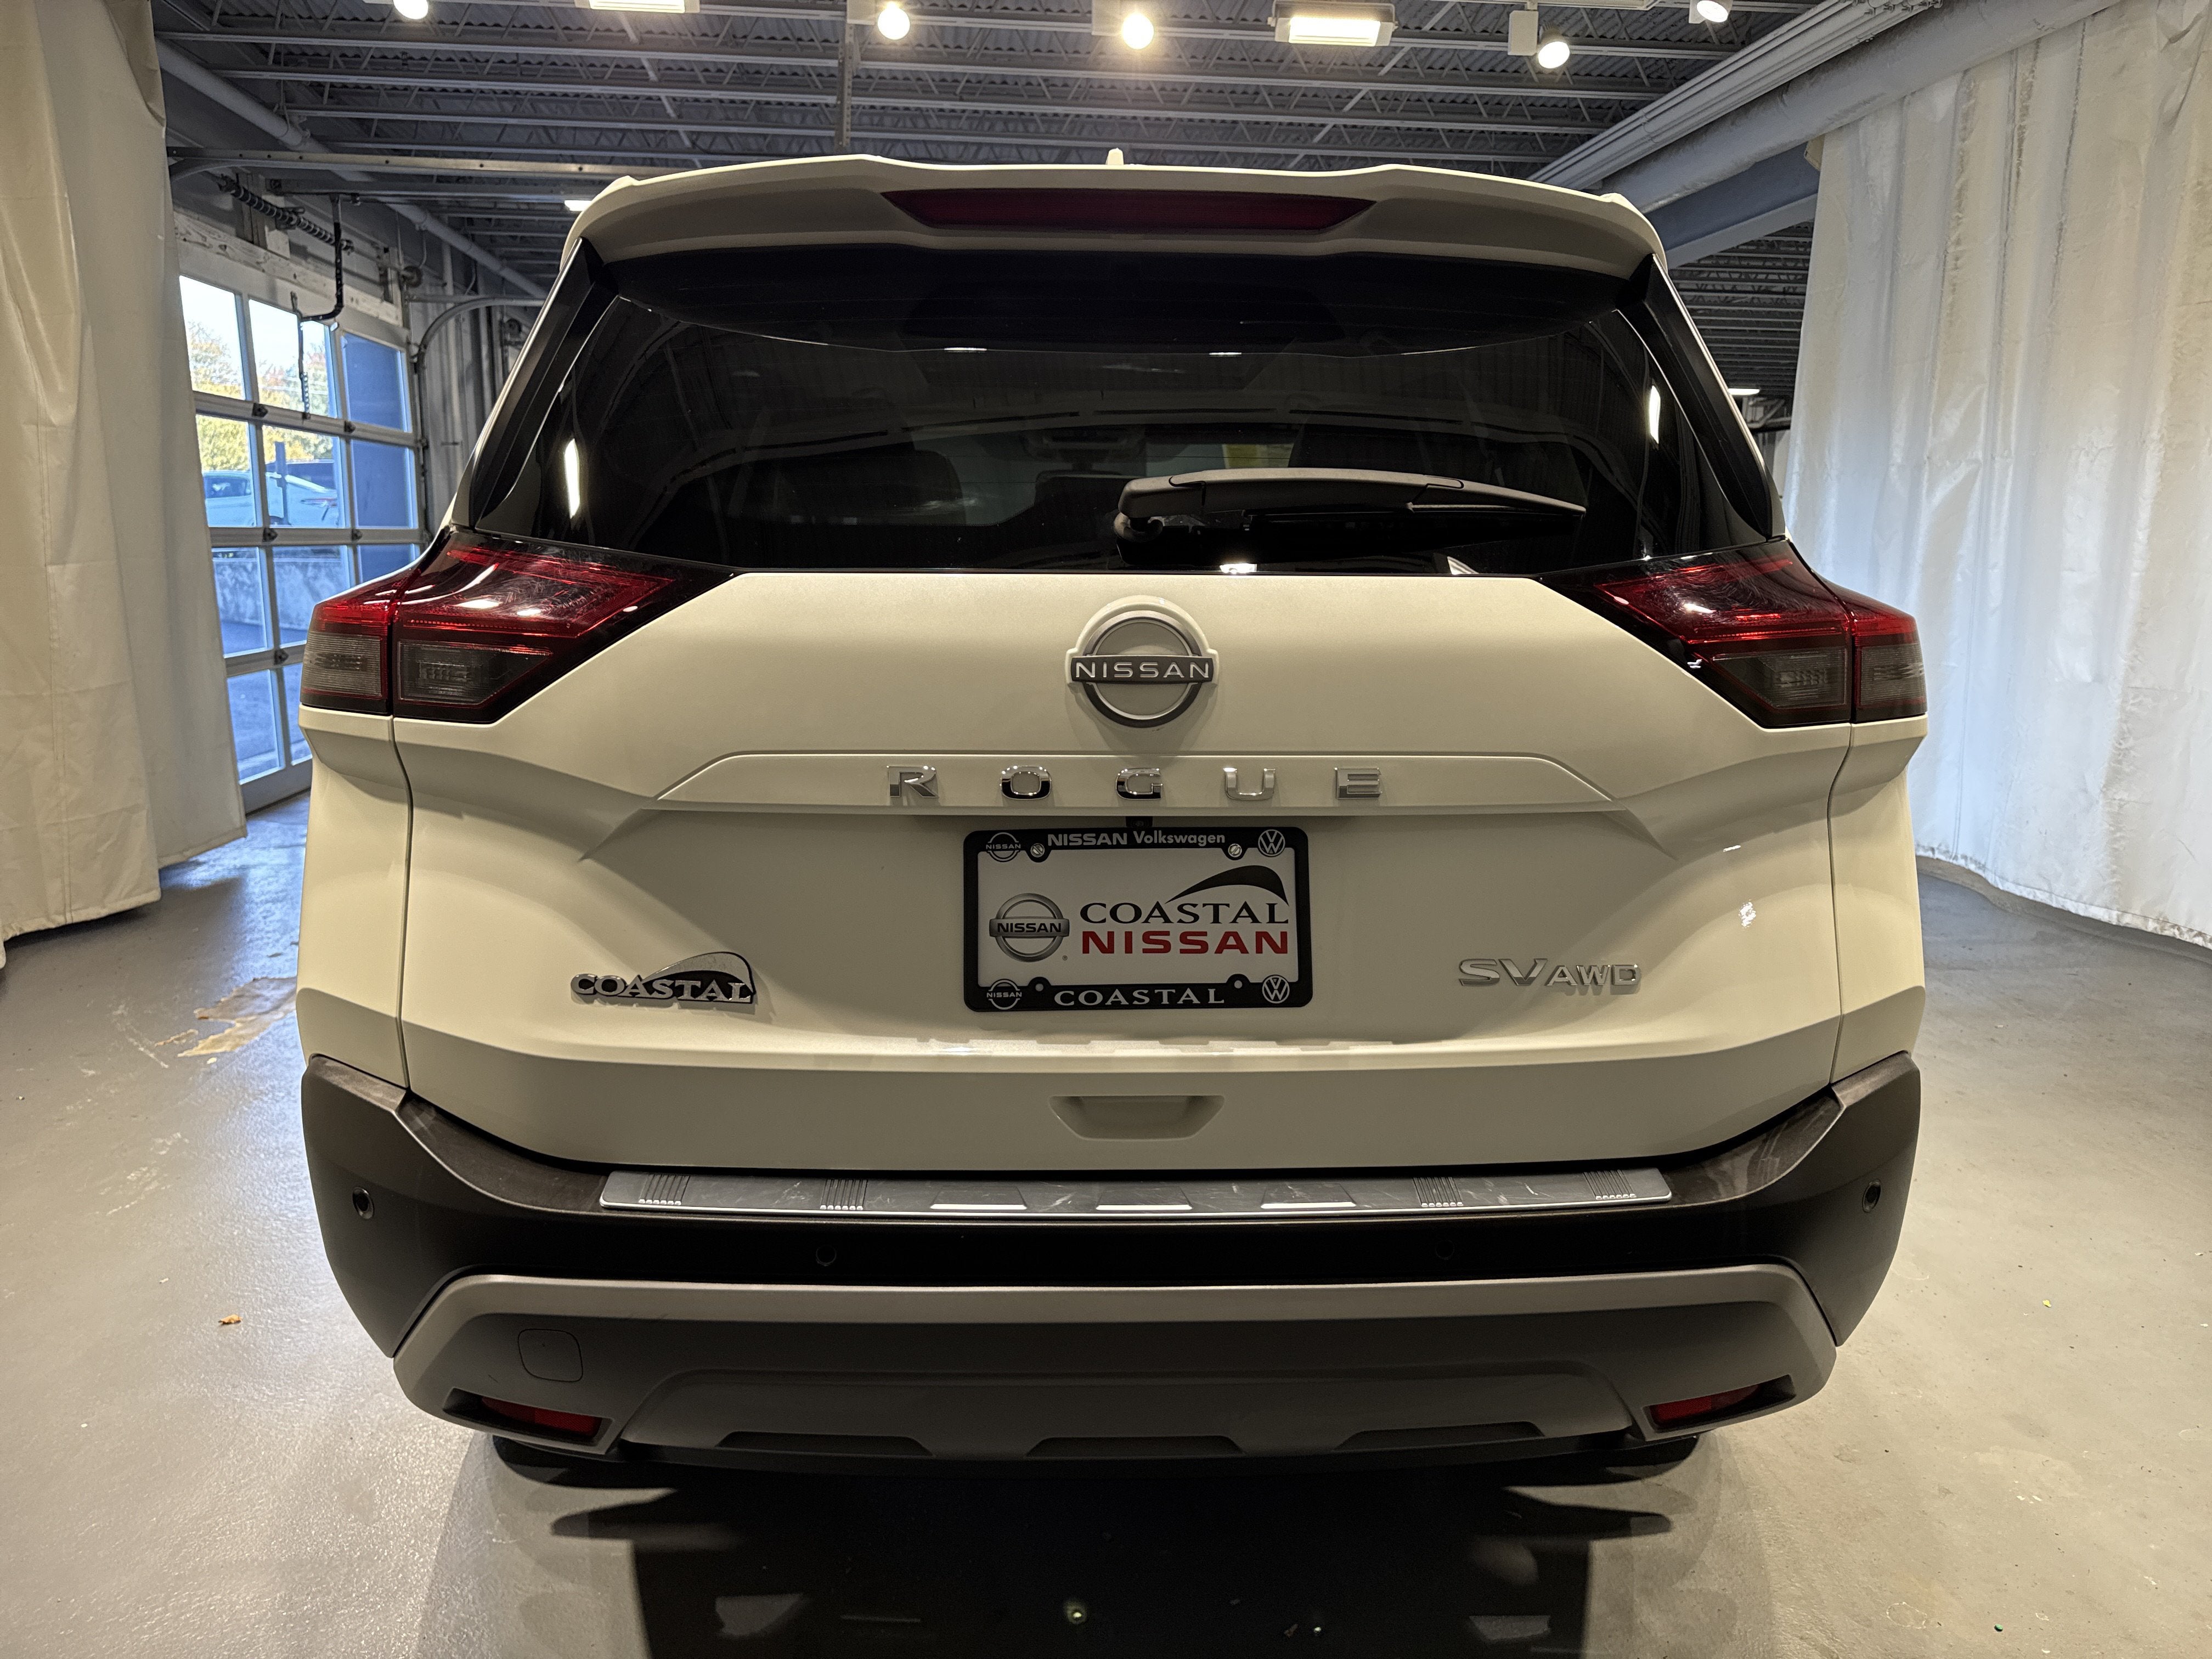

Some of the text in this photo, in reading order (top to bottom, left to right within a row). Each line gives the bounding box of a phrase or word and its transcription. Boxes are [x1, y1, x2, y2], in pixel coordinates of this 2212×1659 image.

[1076, 662, 1210, 679] NISSAN
[887, 765, 1382, 801] ROGUE
[1048, 830, 1226, 846] NISSAN Volkswagen
[1080, 901, 1289, 924] COASTAL
[997, 923, 1062, 933] NISSAN
[1082, 930, 1288, 954] NISSAN
[1459, 958, 1641, 986] SV AWD
[571, 974, 753, 1003] COASTAL
[1054, 988, 1224, 1006] COASTAL
